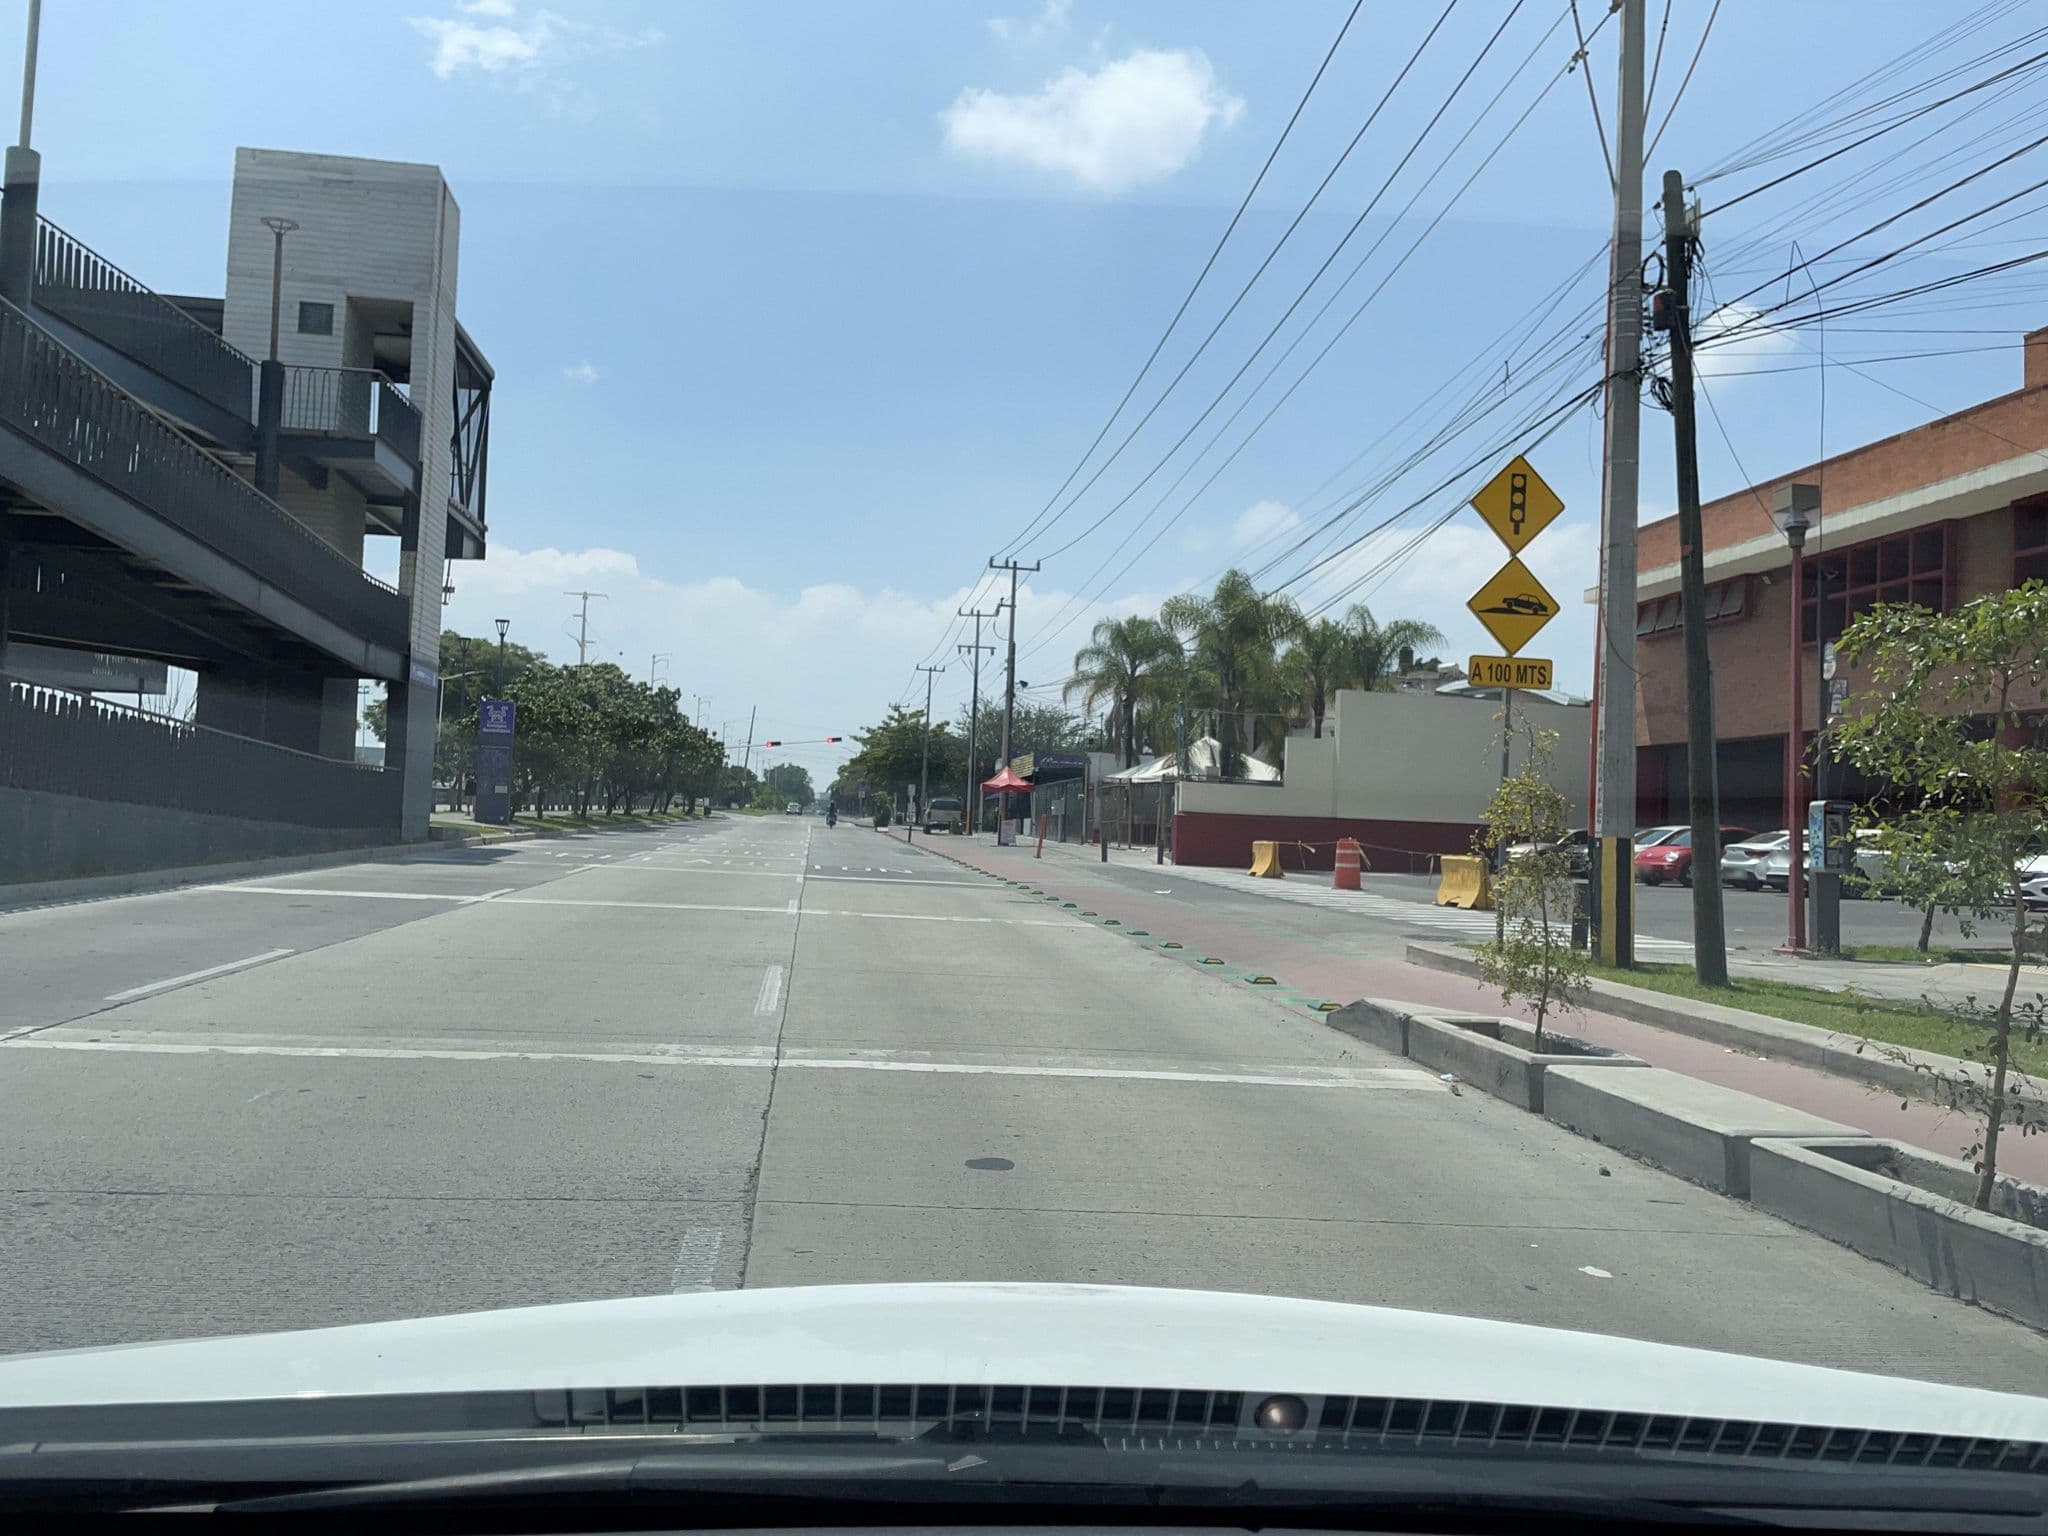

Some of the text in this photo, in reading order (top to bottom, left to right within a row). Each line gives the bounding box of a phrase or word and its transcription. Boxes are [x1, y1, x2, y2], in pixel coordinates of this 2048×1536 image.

[1472, 662, 1551, 685] A 100 MTS.
